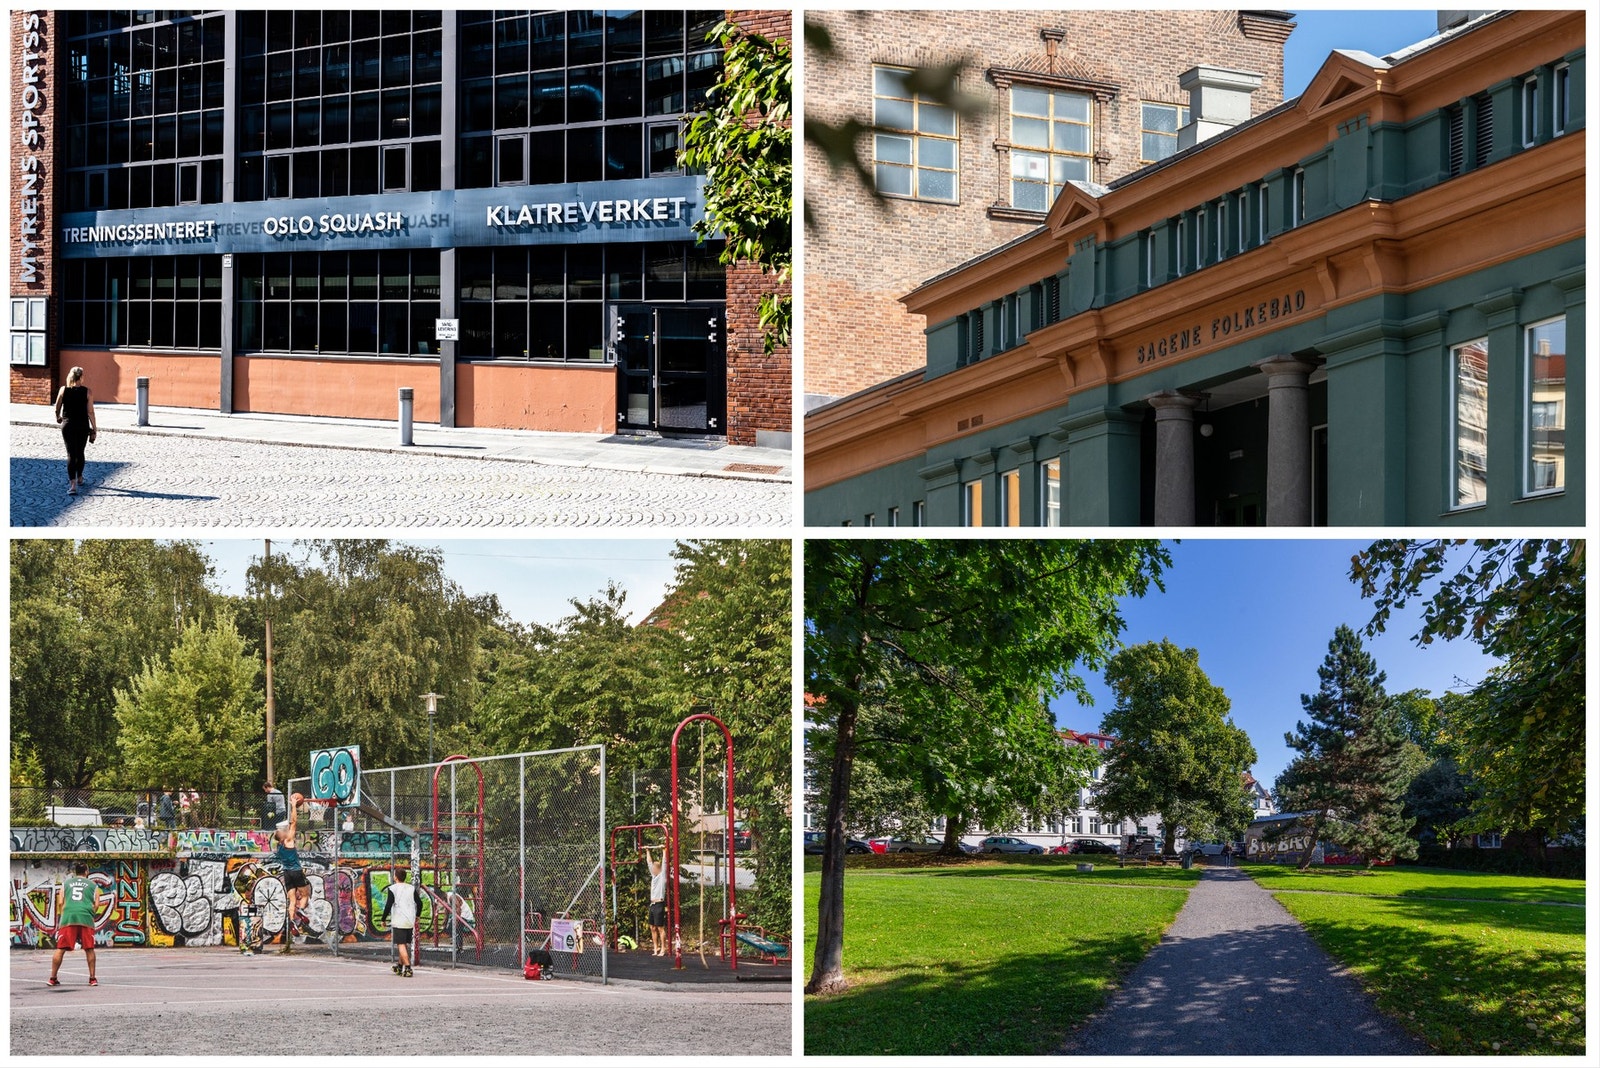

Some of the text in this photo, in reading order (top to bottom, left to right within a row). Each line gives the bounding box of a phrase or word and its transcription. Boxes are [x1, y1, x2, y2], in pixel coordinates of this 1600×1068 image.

[20, 10, 40, 284] MYRENS SPORTSS
[263, 211, 402, 235] OSLO SQUASH
[486, 196, 687, 227] KLATREVERKET
[62, 219, 216, 243] TRENINGSSENTERET
[1136, 288, 1306, 364] SAGENE FOLKEBAD
[71, 886, 84, 901] 5
